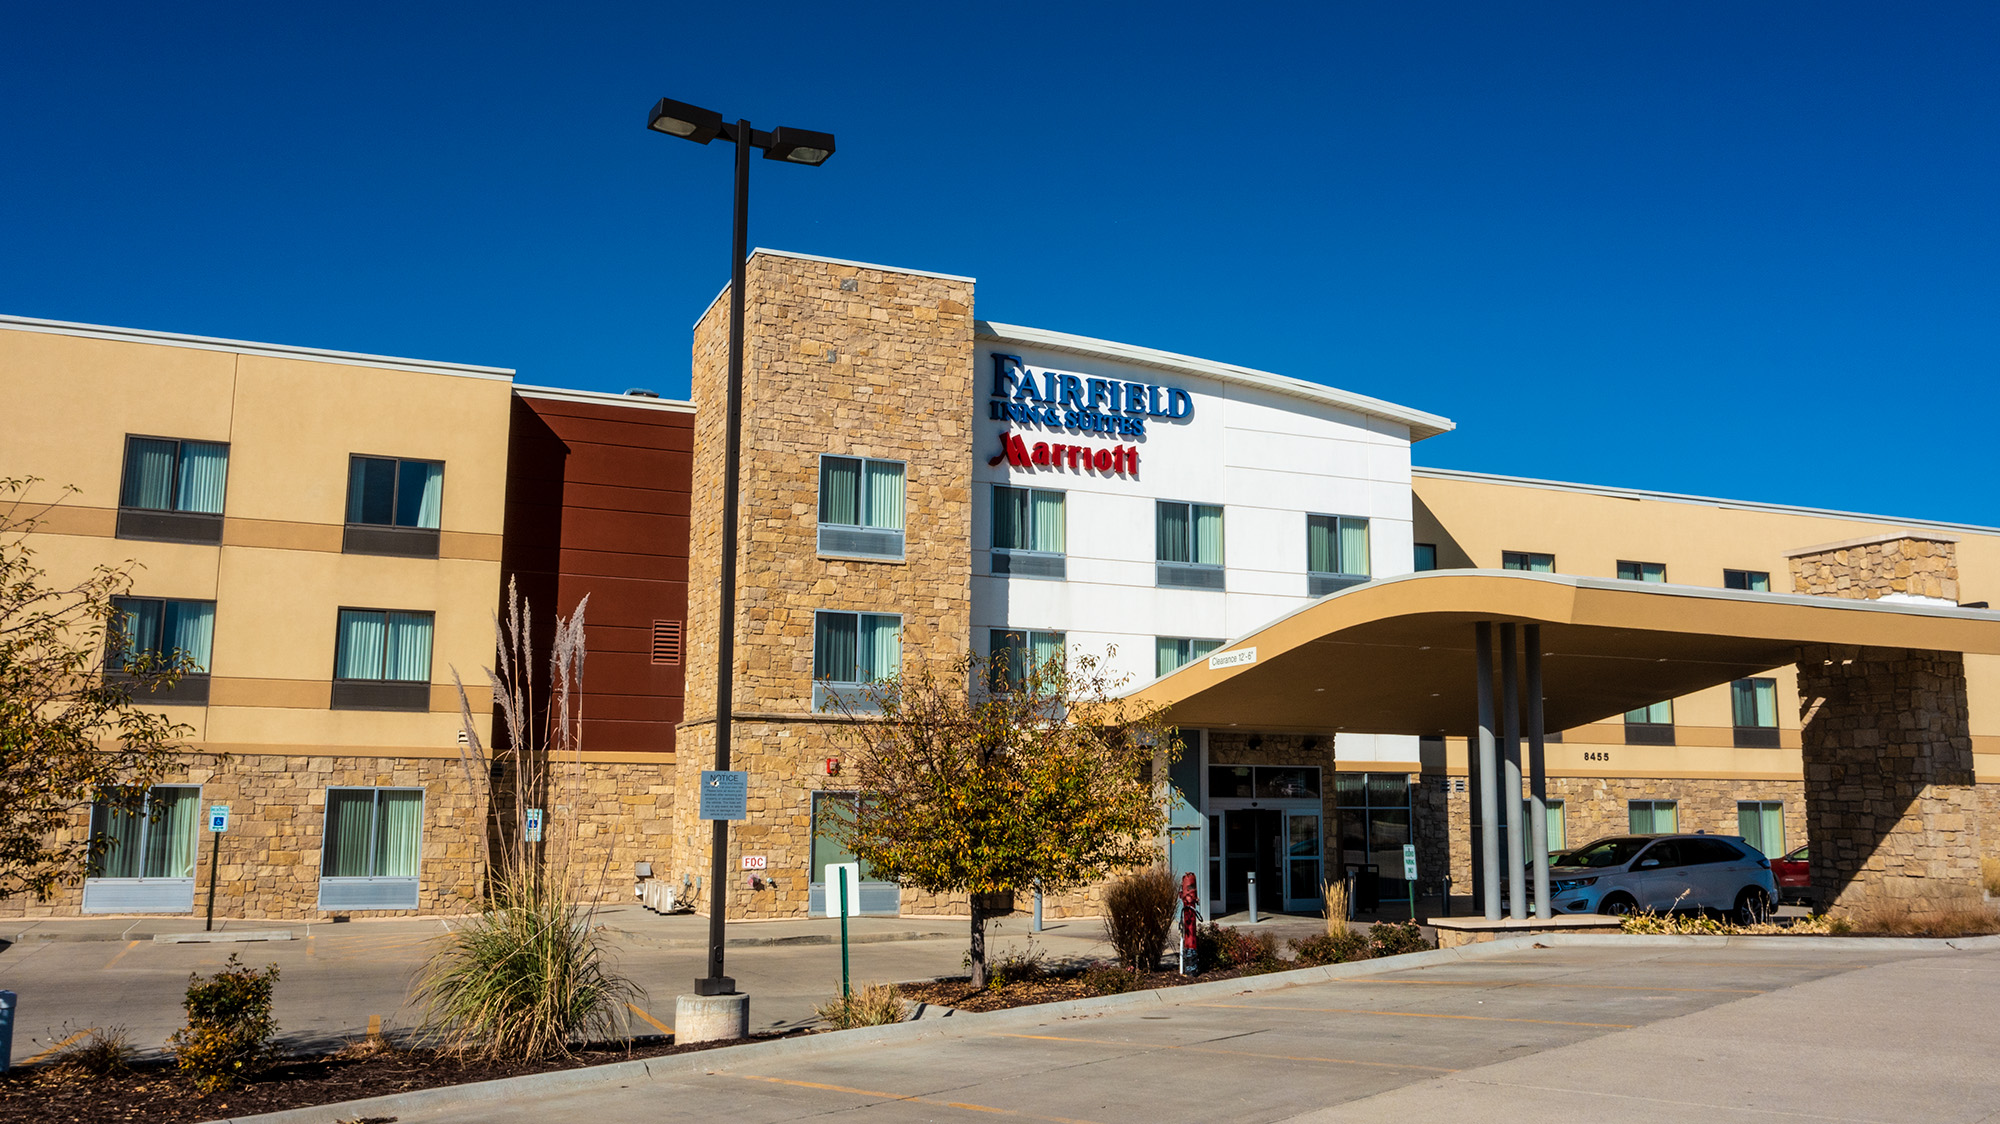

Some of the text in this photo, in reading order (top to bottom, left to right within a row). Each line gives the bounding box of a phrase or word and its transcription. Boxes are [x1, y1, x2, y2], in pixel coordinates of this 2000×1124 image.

[990, 353, 1193, 418] FAIRFIELD
[989, 400, 1145, 436] INN & SUITES
[988, 431, 1139, 475] Marriott
[1211, 656, 1237, 666] Clearance
[1584, 752, 1609, 761] 8455
[744, 857, 764, 867] FDC
